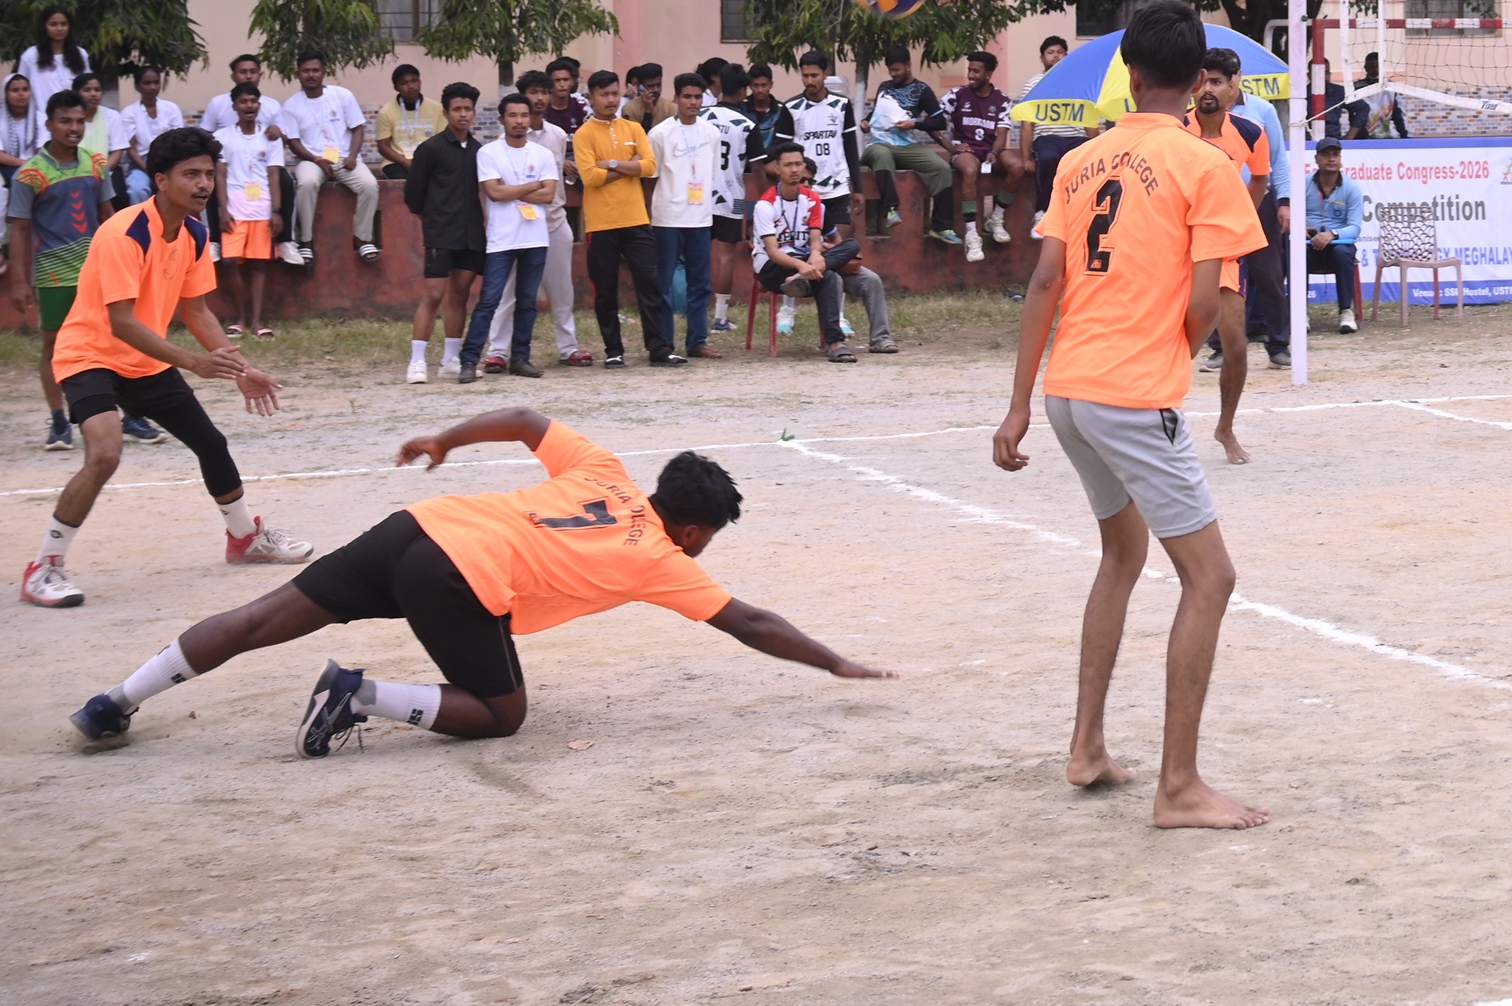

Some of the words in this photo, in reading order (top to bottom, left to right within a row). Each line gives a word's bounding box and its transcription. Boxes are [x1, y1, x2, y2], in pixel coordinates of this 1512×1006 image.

[1242, 77, 1281, 97] STM
[1034, 102, 1085, 123] USTM
[1480, 100, 1499, 111] Vixen
[815, 142, 831, 157] 08
[1064, 157, 1107, 205] JURIA
[1340, 161, 1393, 181] raduate
[1396, 160, 1490, 185] Congress-2026
[1083, 174, 1127, 277] 2
[1361, 248, 1370, 267] &
